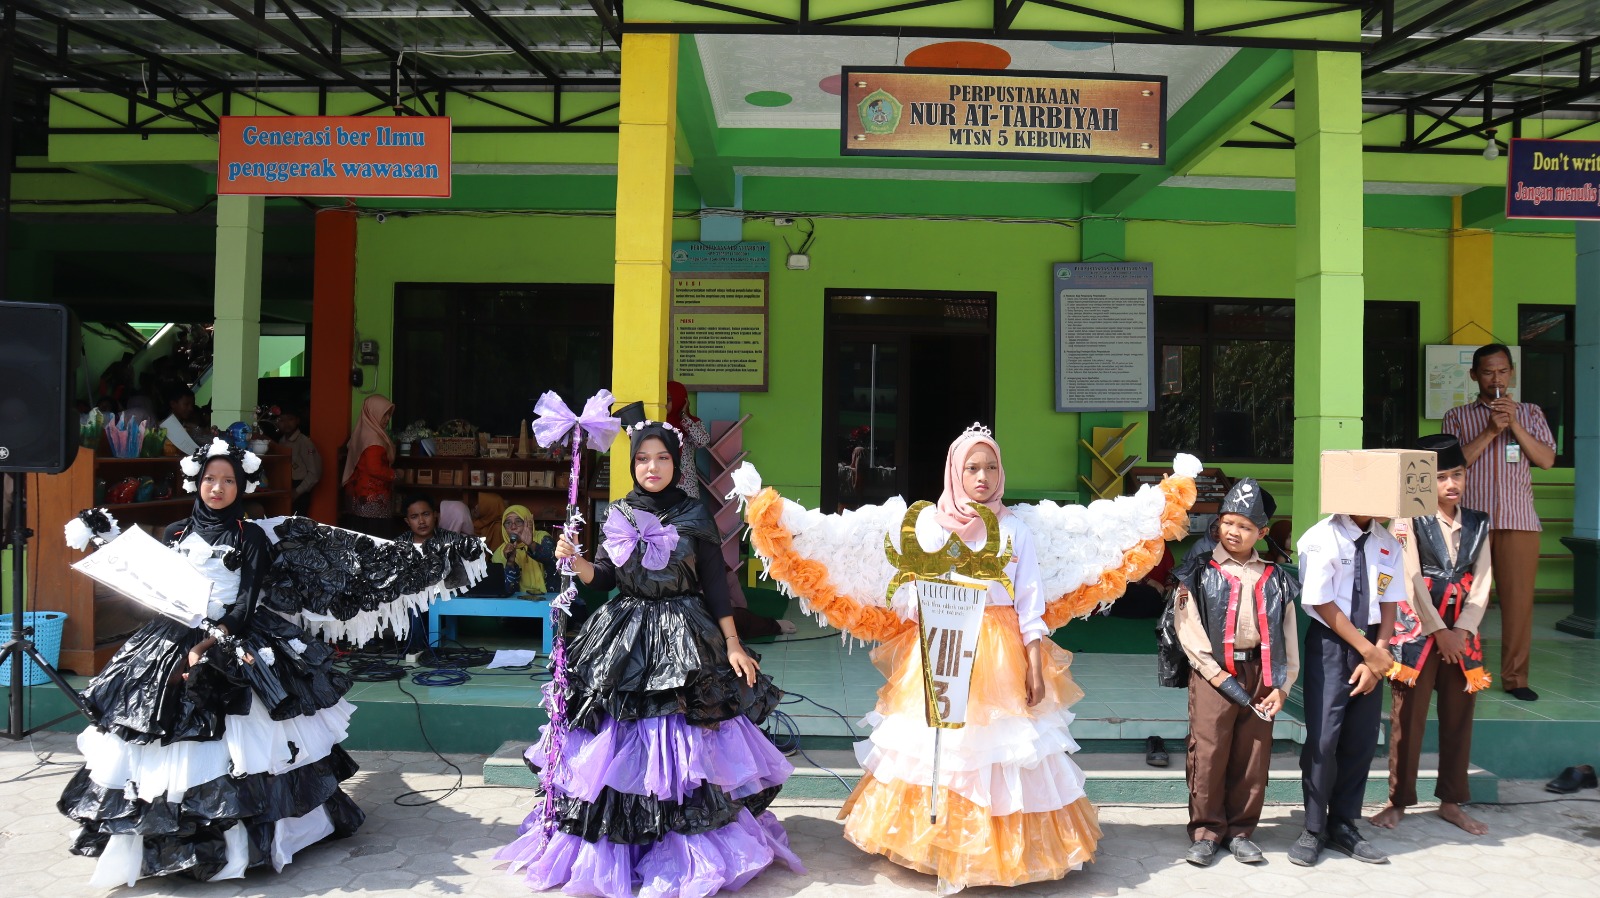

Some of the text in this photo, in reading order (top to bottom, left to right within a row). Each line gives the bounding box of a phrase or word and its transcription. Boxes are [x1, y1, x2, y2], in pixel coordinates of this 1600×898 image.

[949, 85, 1080, 104] PERPUSTAKAAN
[910, 102, 957, 126] NUR
[964, 104, 1120, 131] AT-TARBIYAH
[242, 125, 426, 147] Generasi ber Ilmu
[948, 128, 1092, 149] MTsN 5 KEBUMEN
[228, 158, 439, 183] penggerak wawasan
[1533, 151, 1569, 171] Don't
[1515, 181, 1553, 205] Jangan
[1554, 183, 1597, 202] menulis
